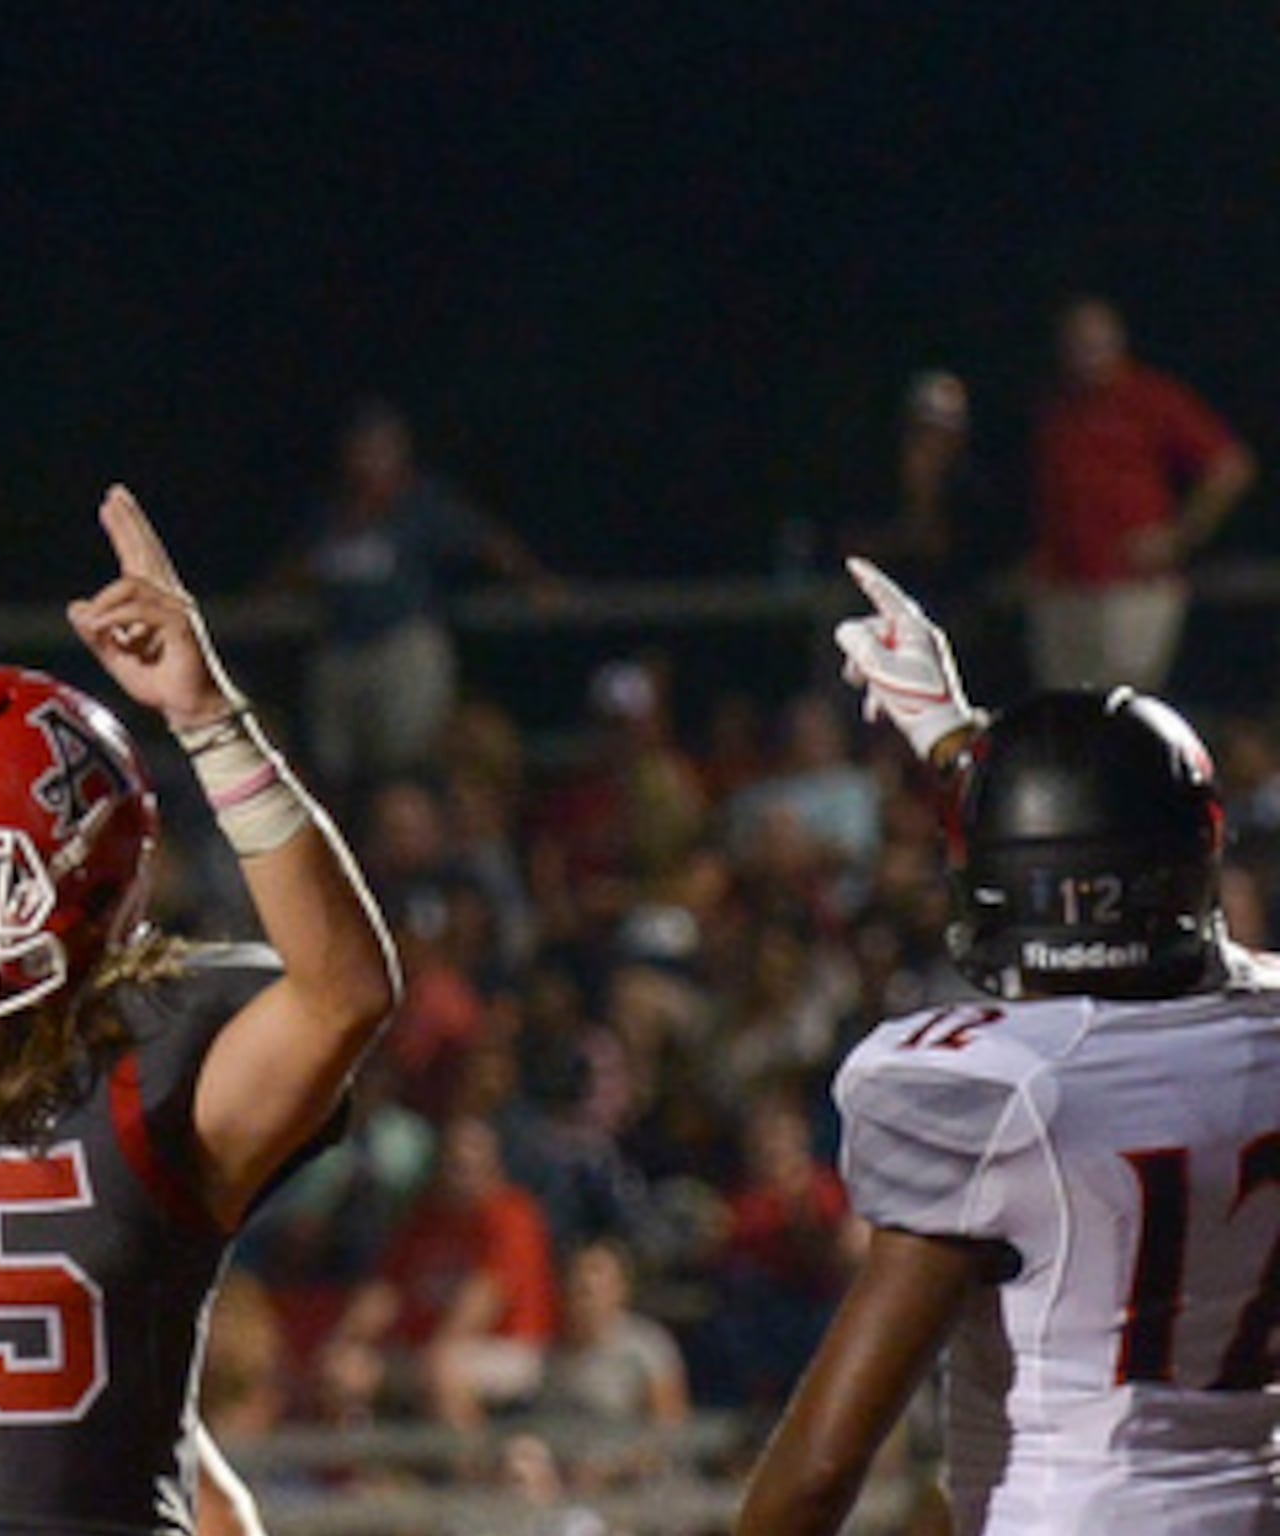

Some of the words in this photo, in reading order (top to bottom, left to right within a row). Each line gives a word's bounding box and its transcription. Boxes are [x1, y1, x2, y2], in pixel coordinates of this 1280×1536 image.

[26, 697, 138, 840] A
[1059, 875, 1123, 925] 12
[1021, 941, 1149, 971] Riddell
